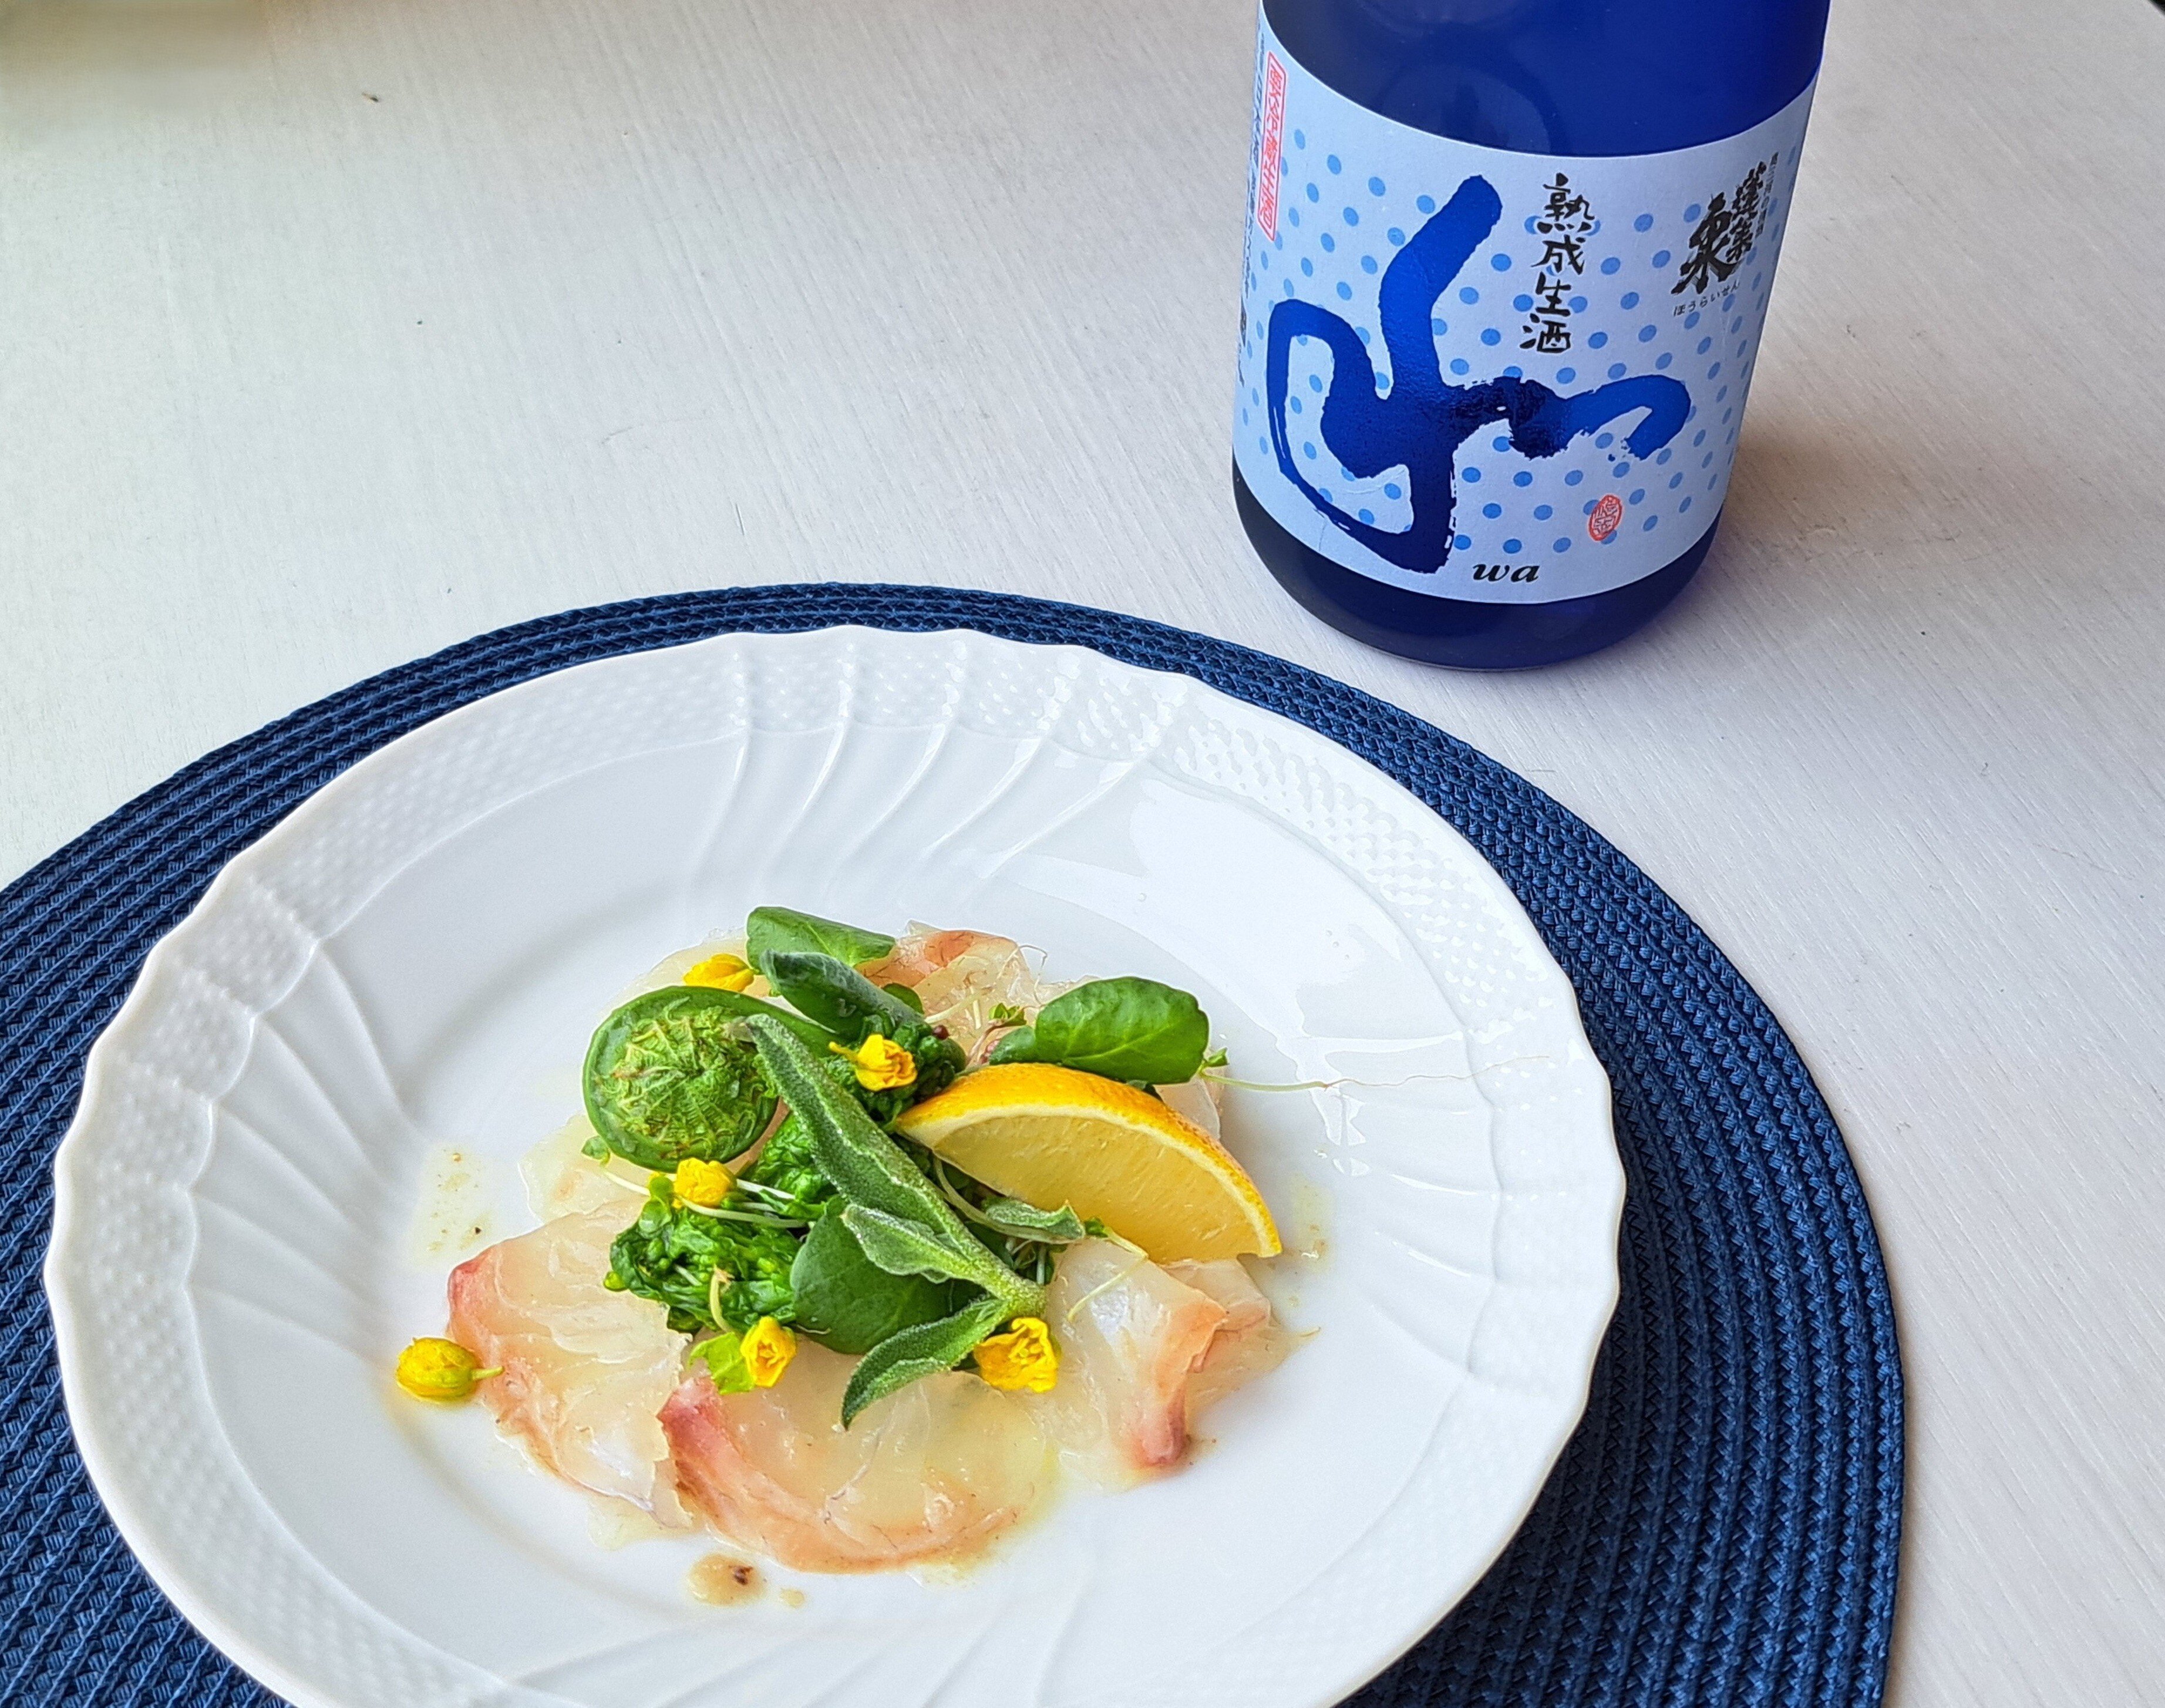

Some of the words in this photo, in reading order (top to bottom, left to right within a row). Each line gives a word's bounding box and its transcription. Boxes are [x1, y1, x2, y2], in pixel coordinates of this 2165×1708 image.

[1519, 172, 1595, 353] 熟成生酒
[1672, 279, 1741, 317] ほうらいせん
[1472, 562, 1540, 583] wa
